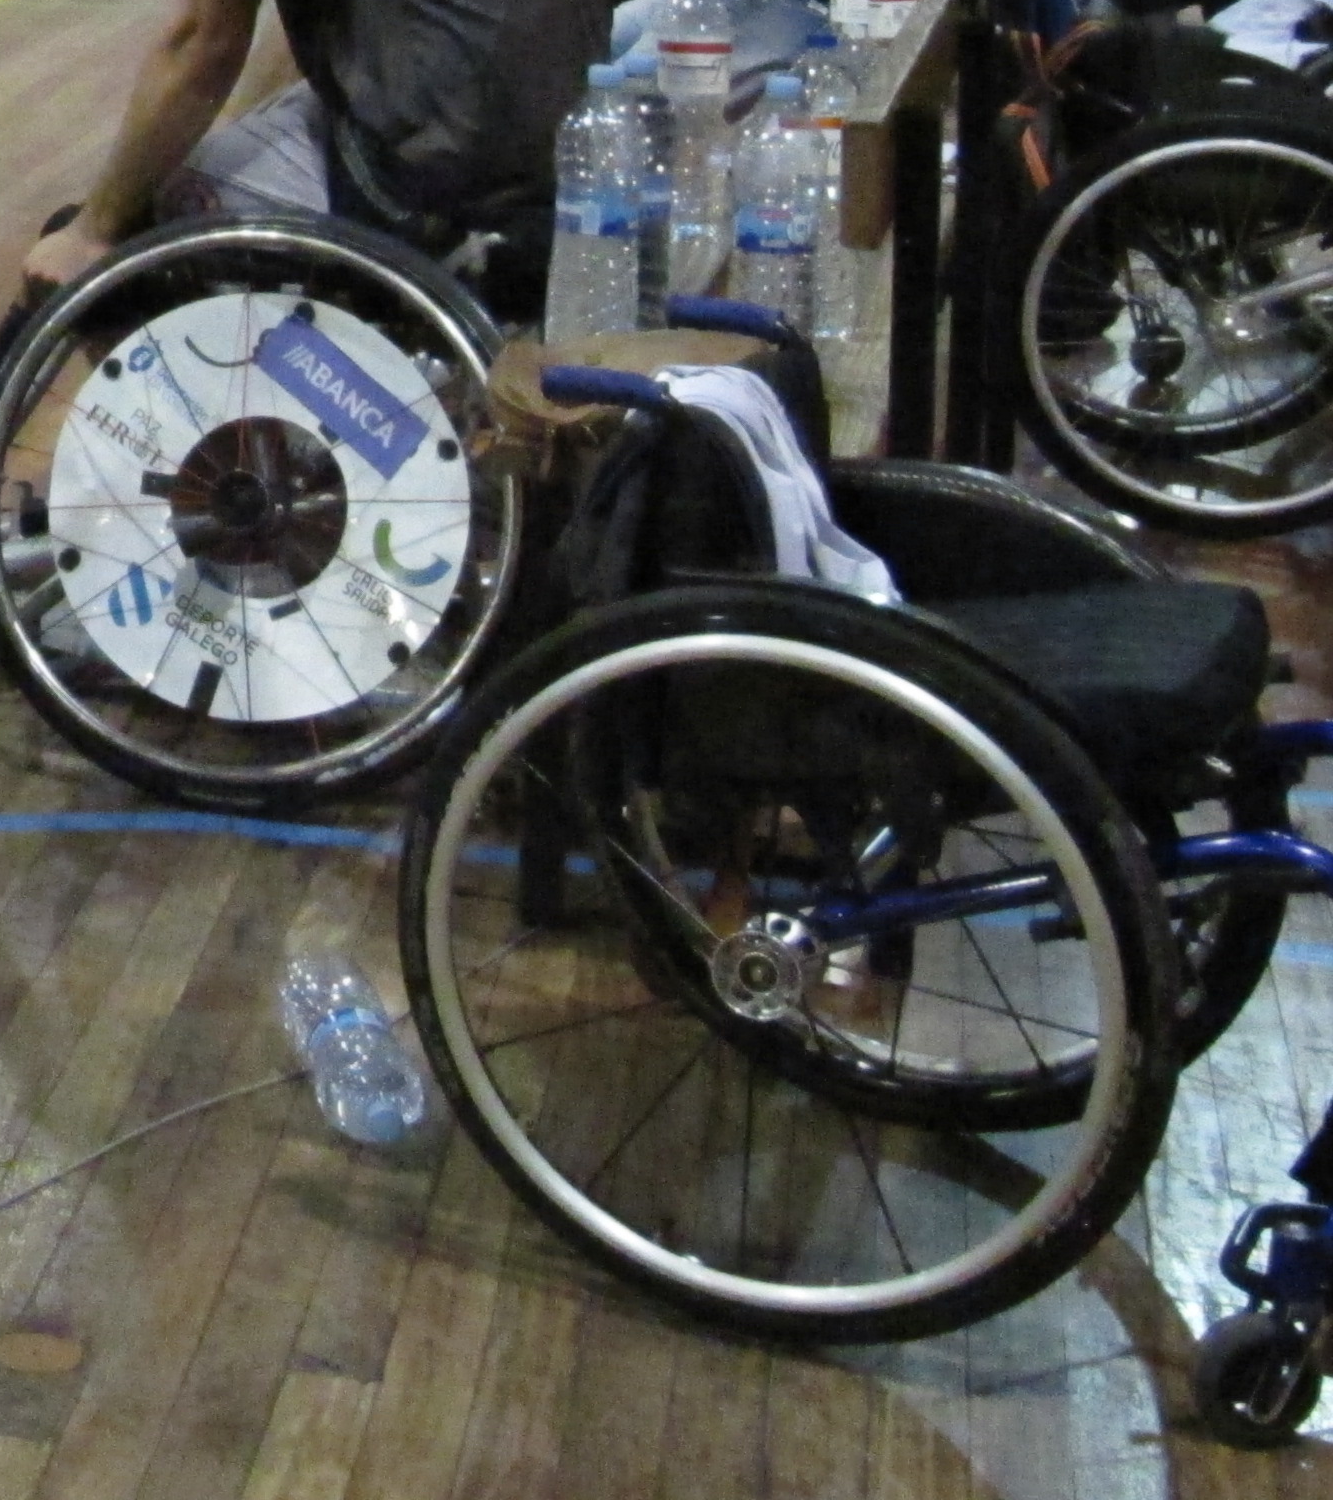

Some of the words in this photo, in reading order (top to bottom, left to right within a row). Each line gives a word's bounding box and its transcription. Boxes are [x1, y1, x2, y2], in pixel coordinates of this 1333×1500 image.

[292, 349, 395, 449] ABANCA
[165, 611, 237, 665] GALEGO
[175, 594, 259, 657] DEPORTE
